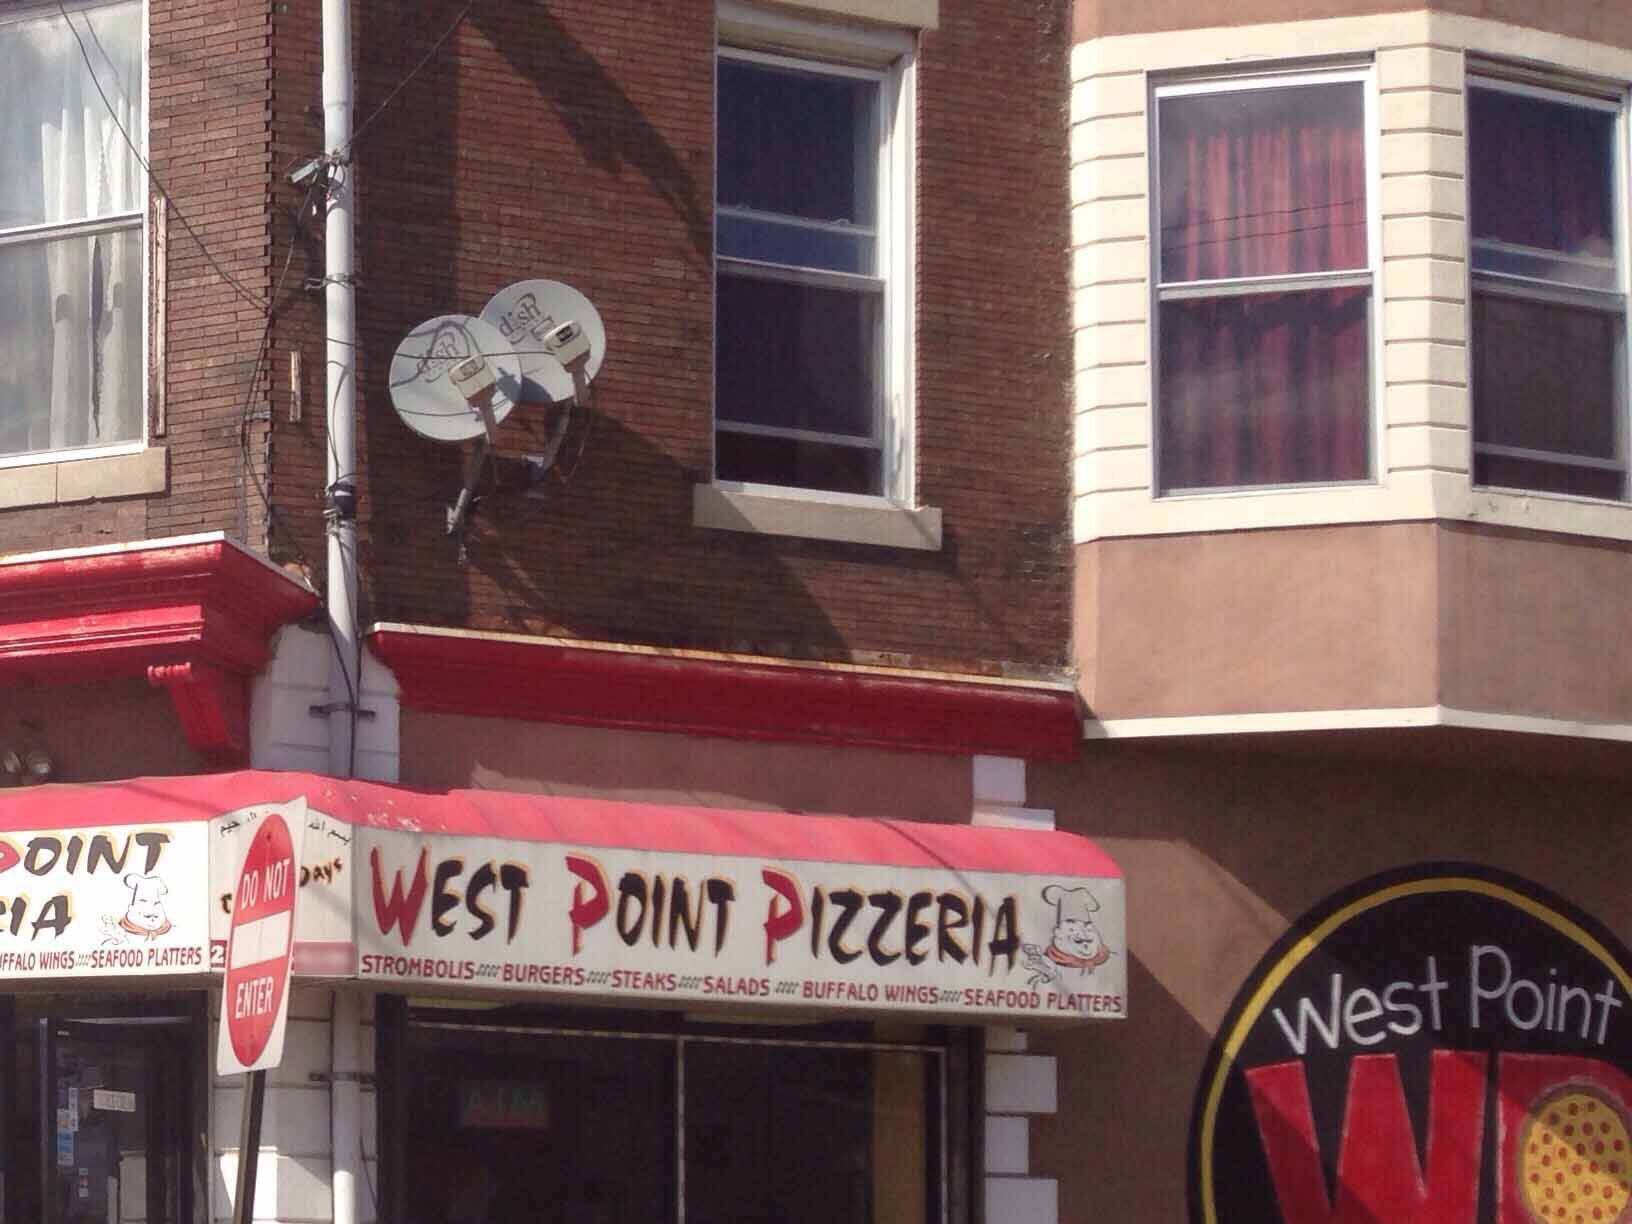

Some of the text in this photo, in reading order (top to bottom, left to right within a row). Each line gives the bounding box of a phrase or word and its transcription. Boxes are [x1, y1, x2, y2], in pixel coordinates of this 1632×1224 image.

[241, 872, 258, 909] DO
[263, 857, 292, 903] NOT
[371, 843, 1024, 976] WEST POINT PIZZERIA
[39, 950, 75, 969] WINGS
[91, 948, 144, 969] SEAFOOD
[147, 947, 202, 967] PLATTERS
[361, 954, 476, 980] STROMBOLIS
[502, 963, 586, 986] BURGERS
[611, 969, 677, 991] STEAKS
[703, 975, 770, 997] SALADS
[802, 980, 879, 1001] BUFFALO
[885, 985, 939, 1004] WINGS
[963, 988, 1041, 1009] SEAFOOD
[1046, 991, 1122, 1013] PLATTERS
[235, 976, 274, 1020] ENTER
[1273, 944, 1623, 1055] West Point
